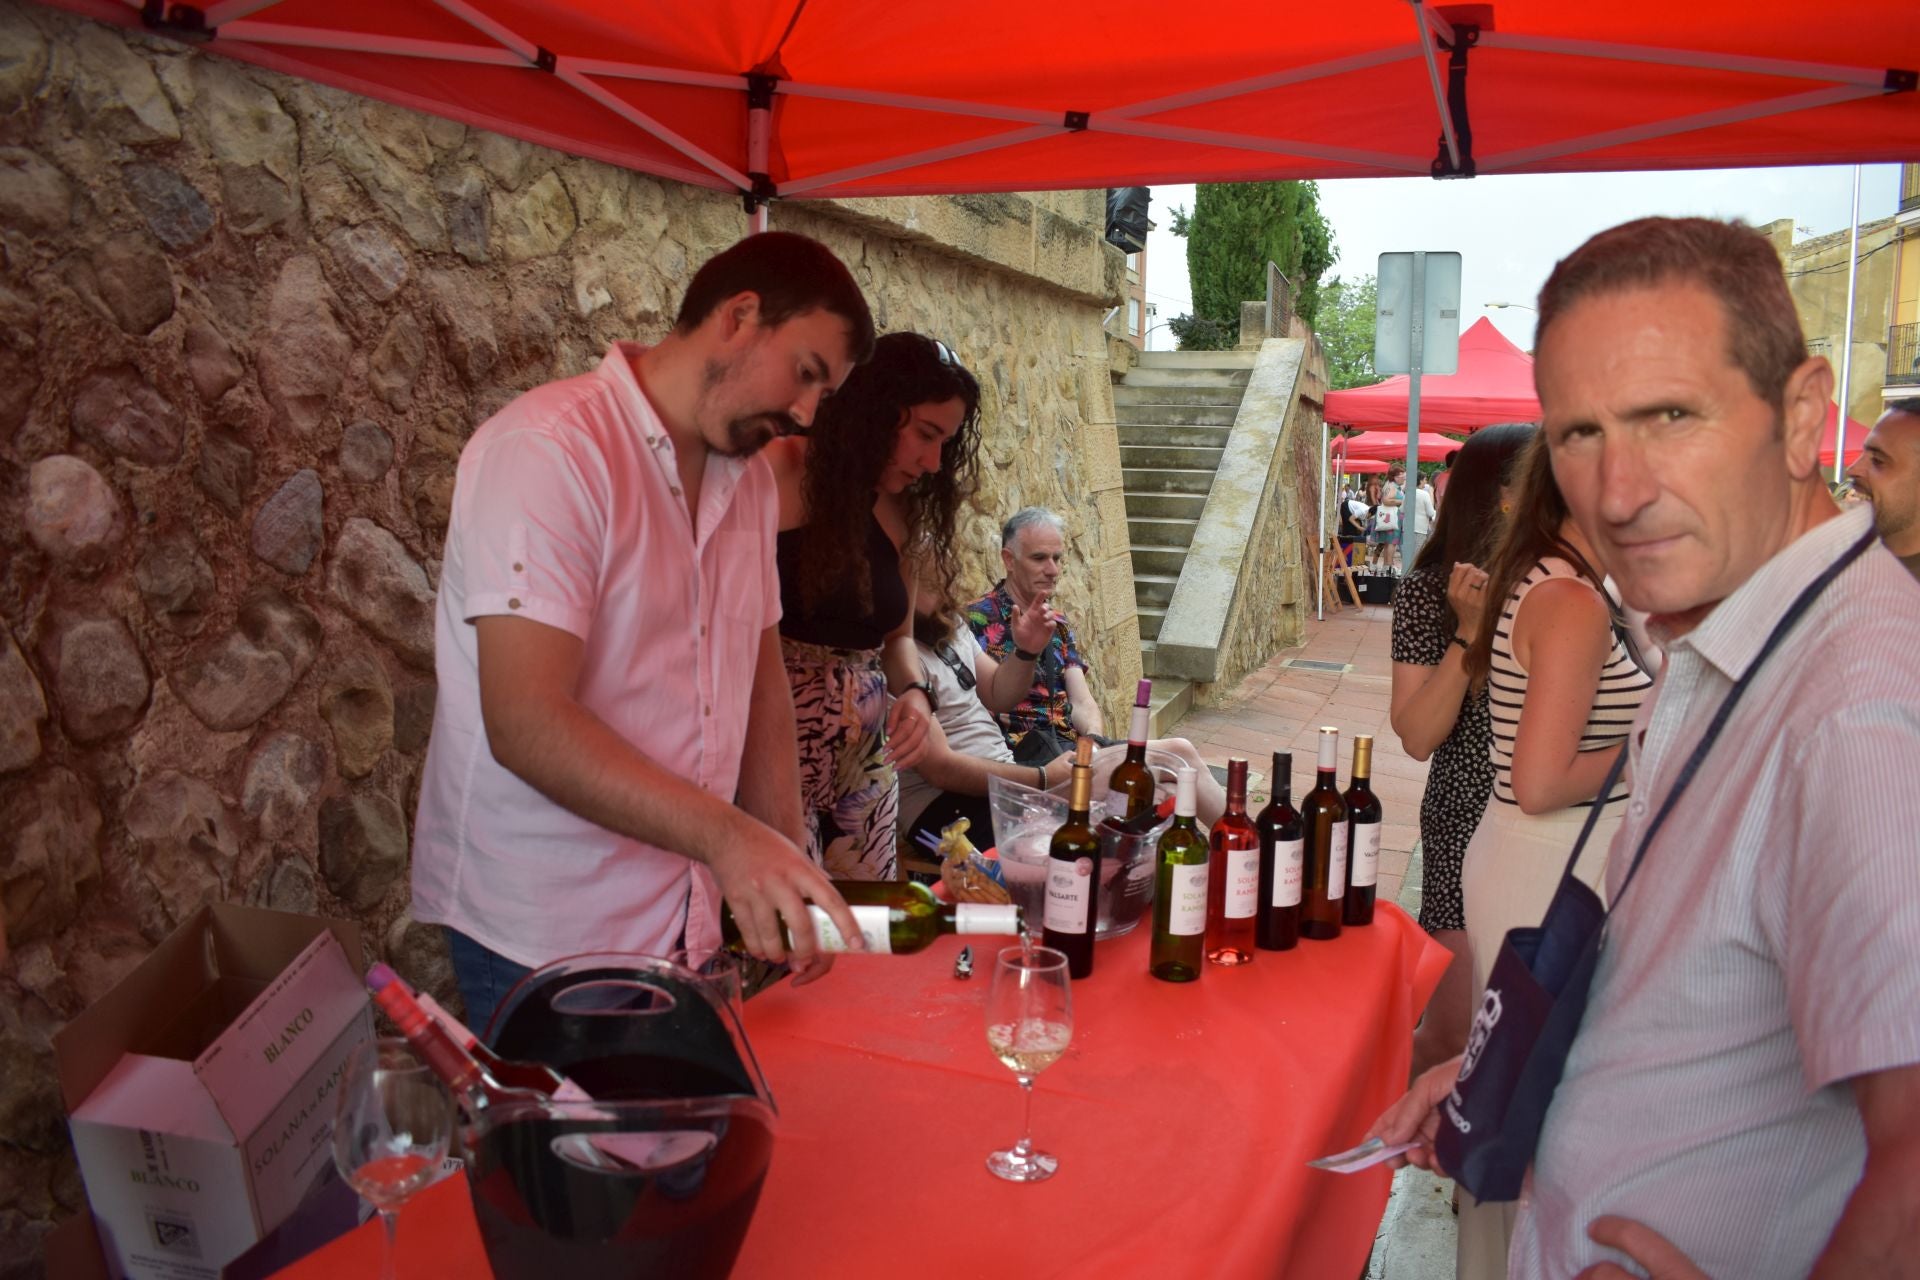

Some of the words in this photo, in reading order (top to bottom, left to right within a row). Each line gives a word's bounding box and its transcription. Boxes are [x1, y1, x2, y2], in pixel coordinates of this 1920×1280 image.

[263, 1007, 314, 1064] BLANCO
[254, 1109, 309, 1175] SOLANA
[130, 1169, 200, 1193] BLANCO
